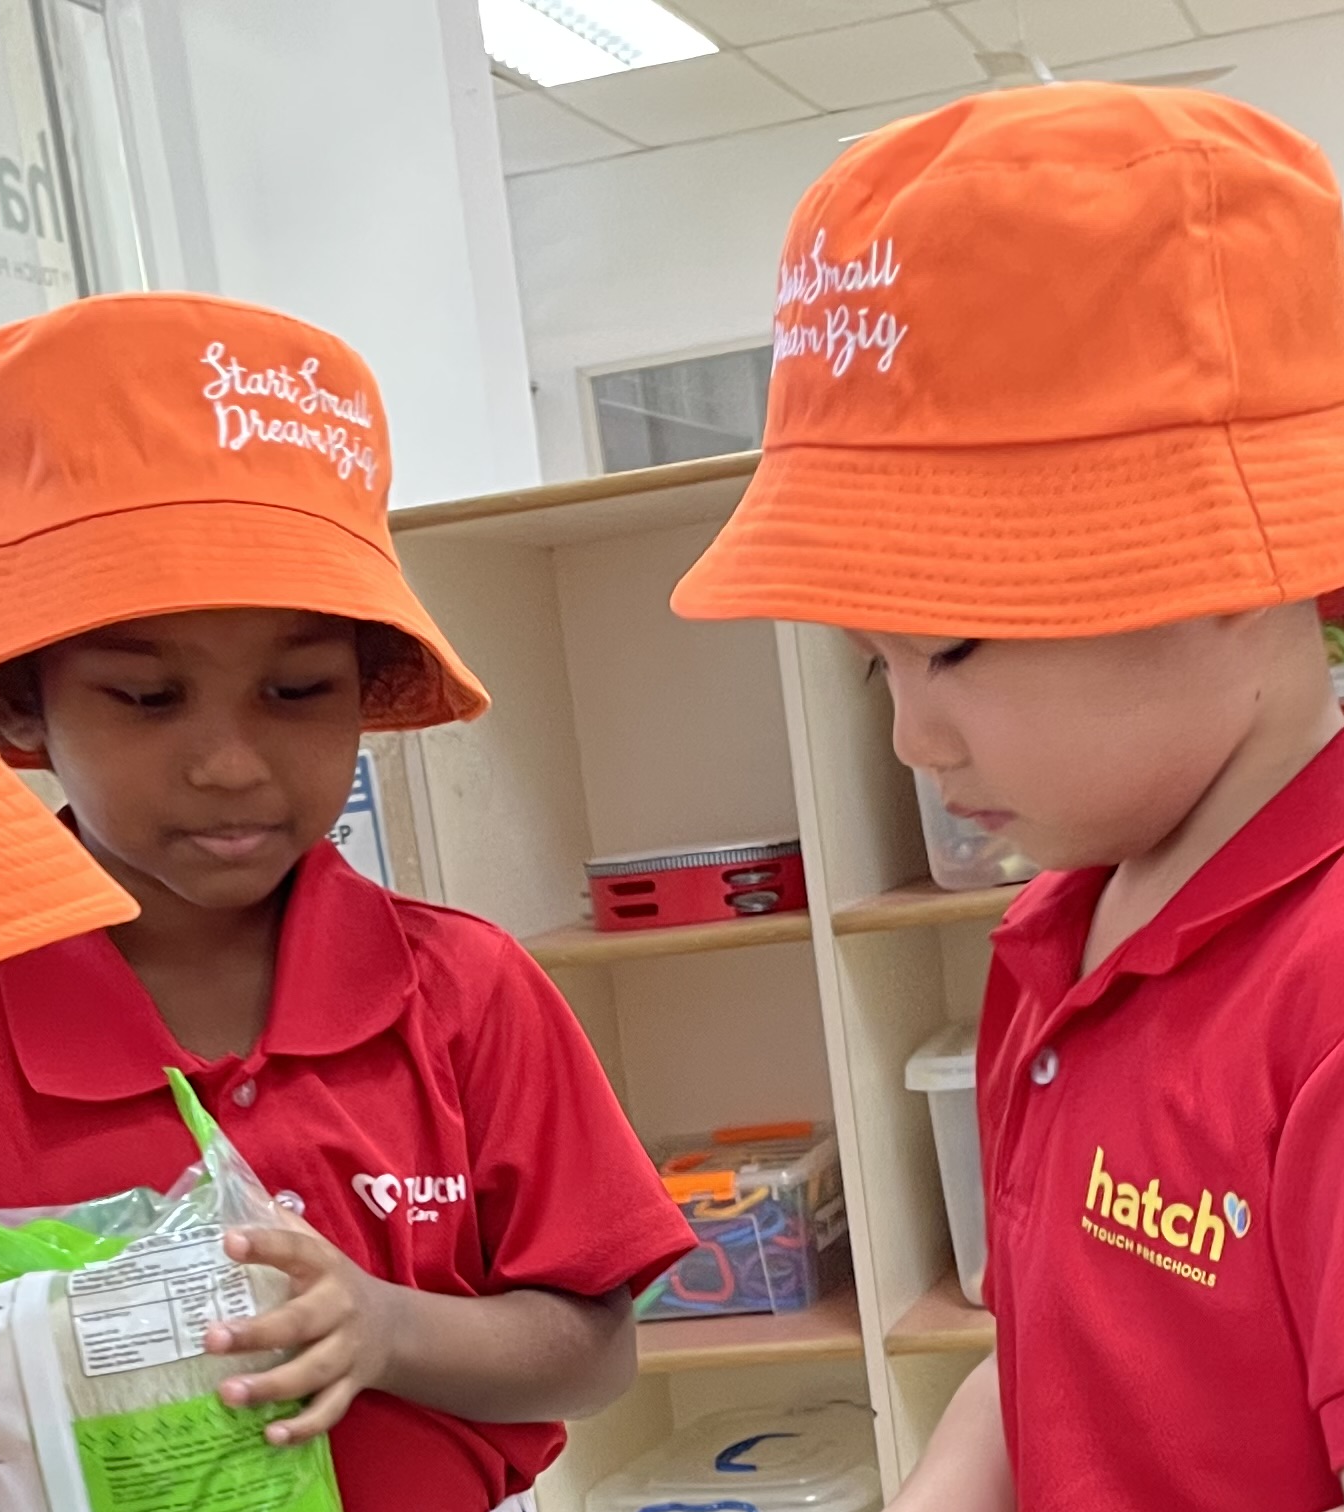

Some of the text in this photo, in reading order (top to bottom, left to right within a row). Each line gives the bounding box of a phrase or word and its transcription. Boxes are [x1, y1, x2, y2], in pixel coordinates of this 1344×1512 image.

[199, 341, 374, 430] Start Small
[213, 400, 378, 492] Dream Big
[1086, 1145, 1226, 1262] hatch
[1092, 1224, 1135, 1253] TOUCH
[1135, 1243, 1217, 1289] PRESCHOOLS
